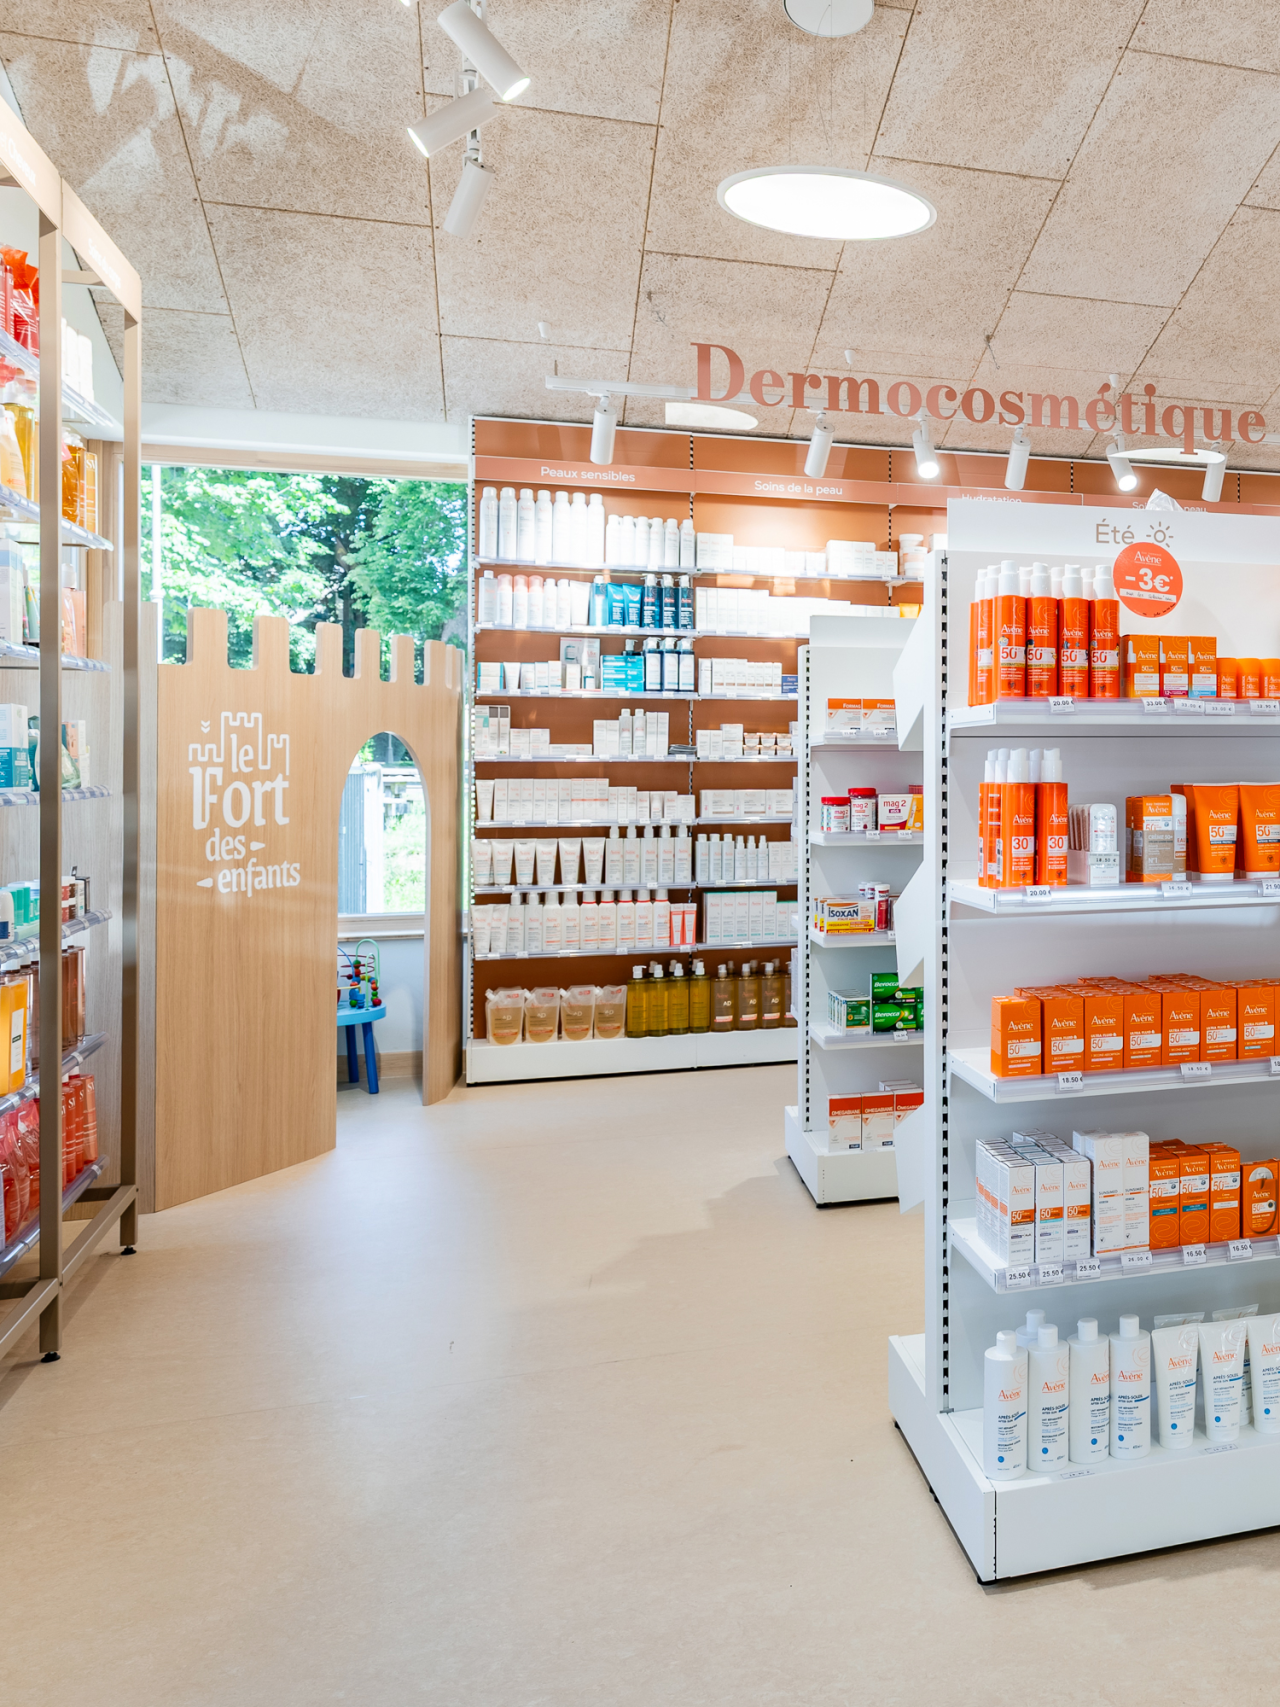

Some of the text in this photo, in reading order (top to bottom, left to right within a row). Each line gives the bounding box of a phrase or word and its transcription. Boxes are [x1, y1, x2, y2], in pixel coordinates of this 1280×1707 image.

[690, 342, 1266, 455] Dermocosmétique
[540, 466, 636, 483] Peaux sensibles
[754, 480, 843, 499] Soins de la peau
[1096, 518, 1135, 545] Été
[230, 733, 254, 774] le
[188, 765, 290, 831] Fort
[883, 800, 900, 809] mag
[1209, 809, 1232, 819] Avène
[1255, 808, 1276, 818] Avène
[205, 827, 246, 862] des
[217, 858, 301, 898] enfants
[1169, 1010, 1194, 1021] Avène
[1206, 1008, 1230, 1019] Avène
[1244, 1005, 1267, 1015] Avène
[1051, 1017, 1077, 1029] Avène
[1091, 1015, 1117, 1027] Avène
[1130, 1012, 1155, 1024] Avène
[1008, 1020, 1034, 1031] Avène
[1061, 1076, 1079, 1084] 18.50
[864, 1106, 894, 1114] OMEGABIANE
[1042, 1270, 1060, 1278] 25.50
[1079, 1264, 1097, 1272] 25.50
[1008, 1272, 1026, 1280] 25.50
[1212, 1351, 1238, 1363] Avène
[1168, 1357, 1193, 1370] Avène
[1118, 1370, 1143, 1382] Avène
